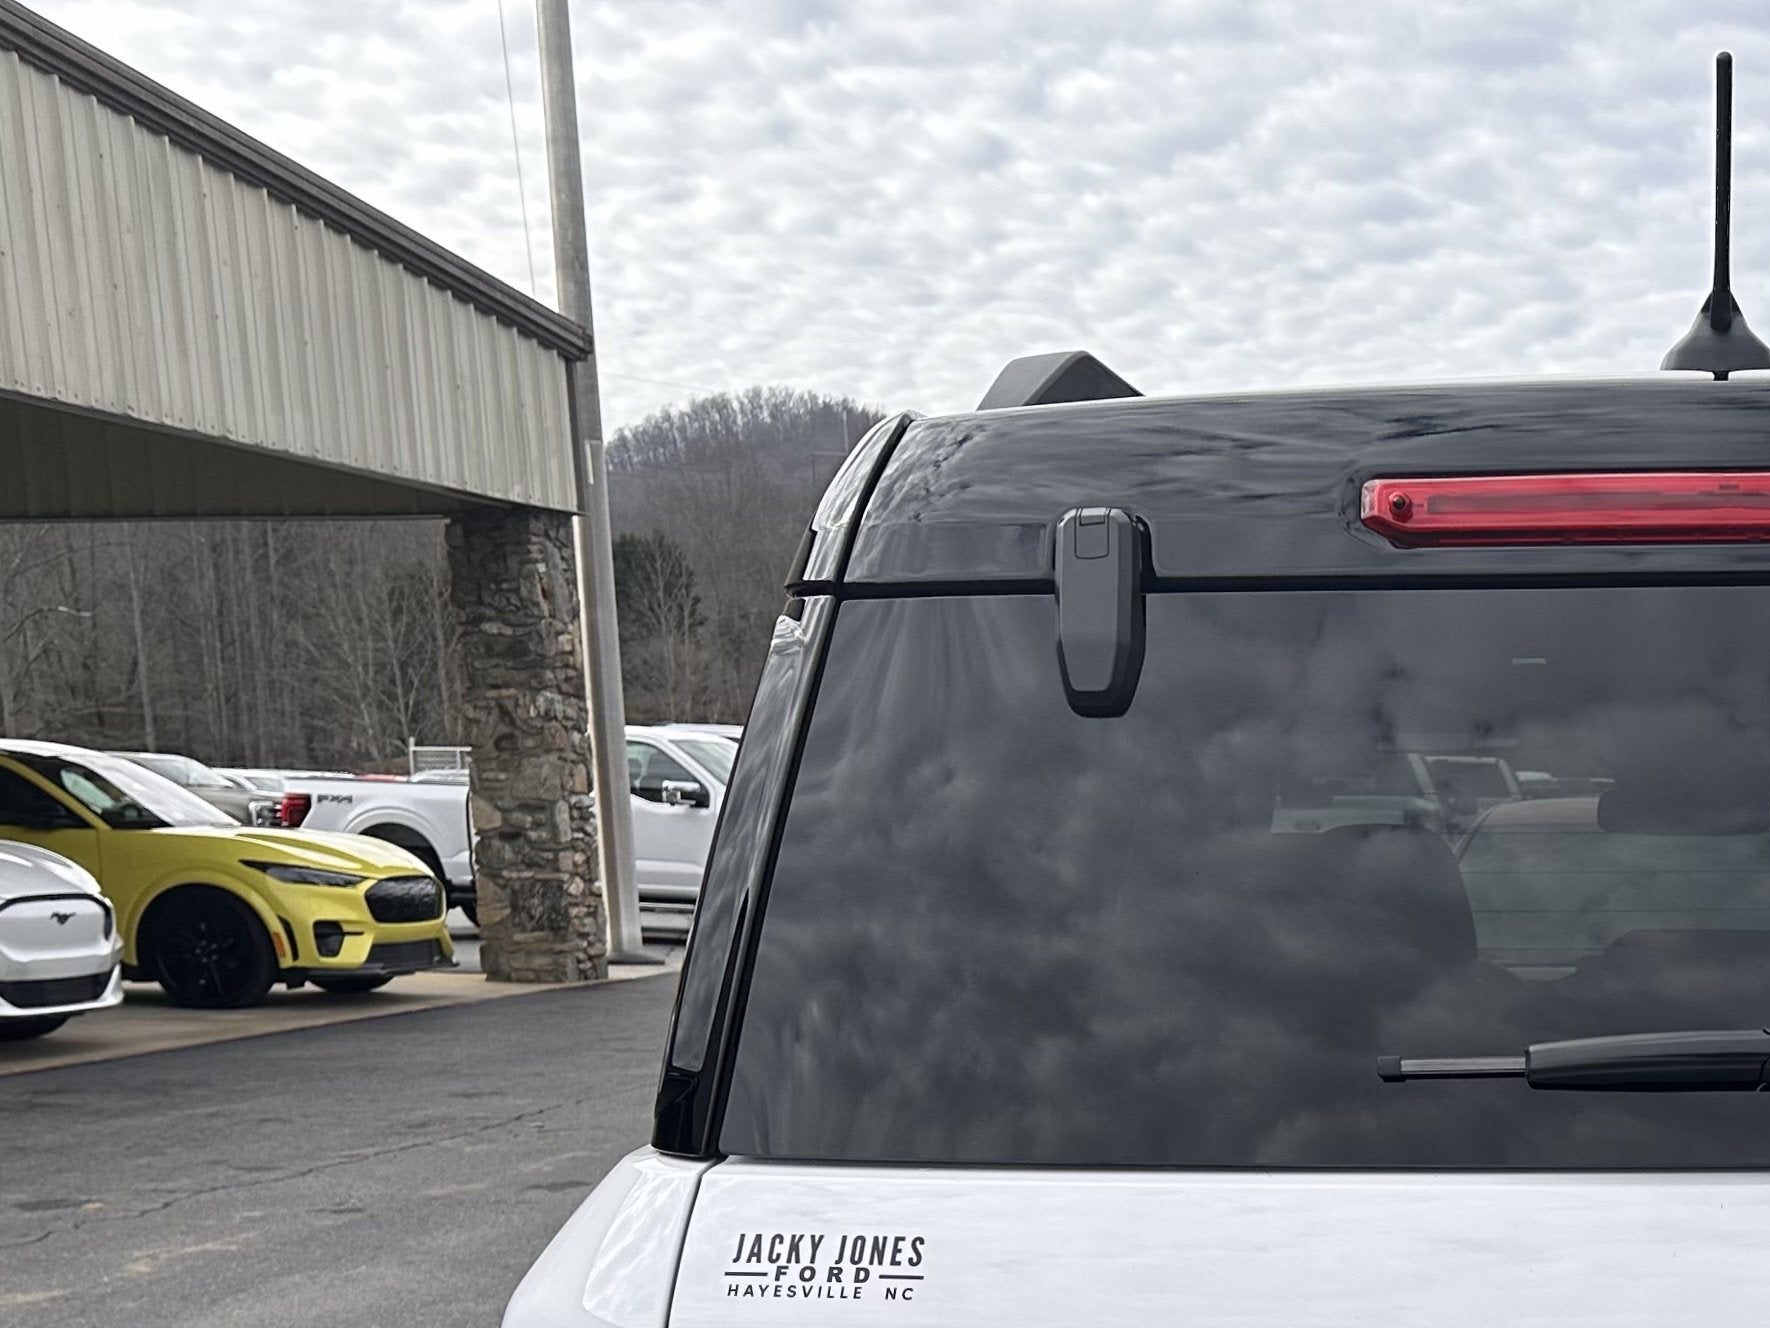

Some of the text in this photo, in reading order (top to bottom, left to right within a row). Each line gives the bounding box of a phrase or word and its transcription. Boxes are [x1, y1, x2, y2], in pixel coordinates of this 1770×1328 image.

[732, 1233, 926, 1267] JACKY JONES
[774, 1265, 871, 1284] FORD
[727, 1283, 915, 1301] HAYESVILLE NC
